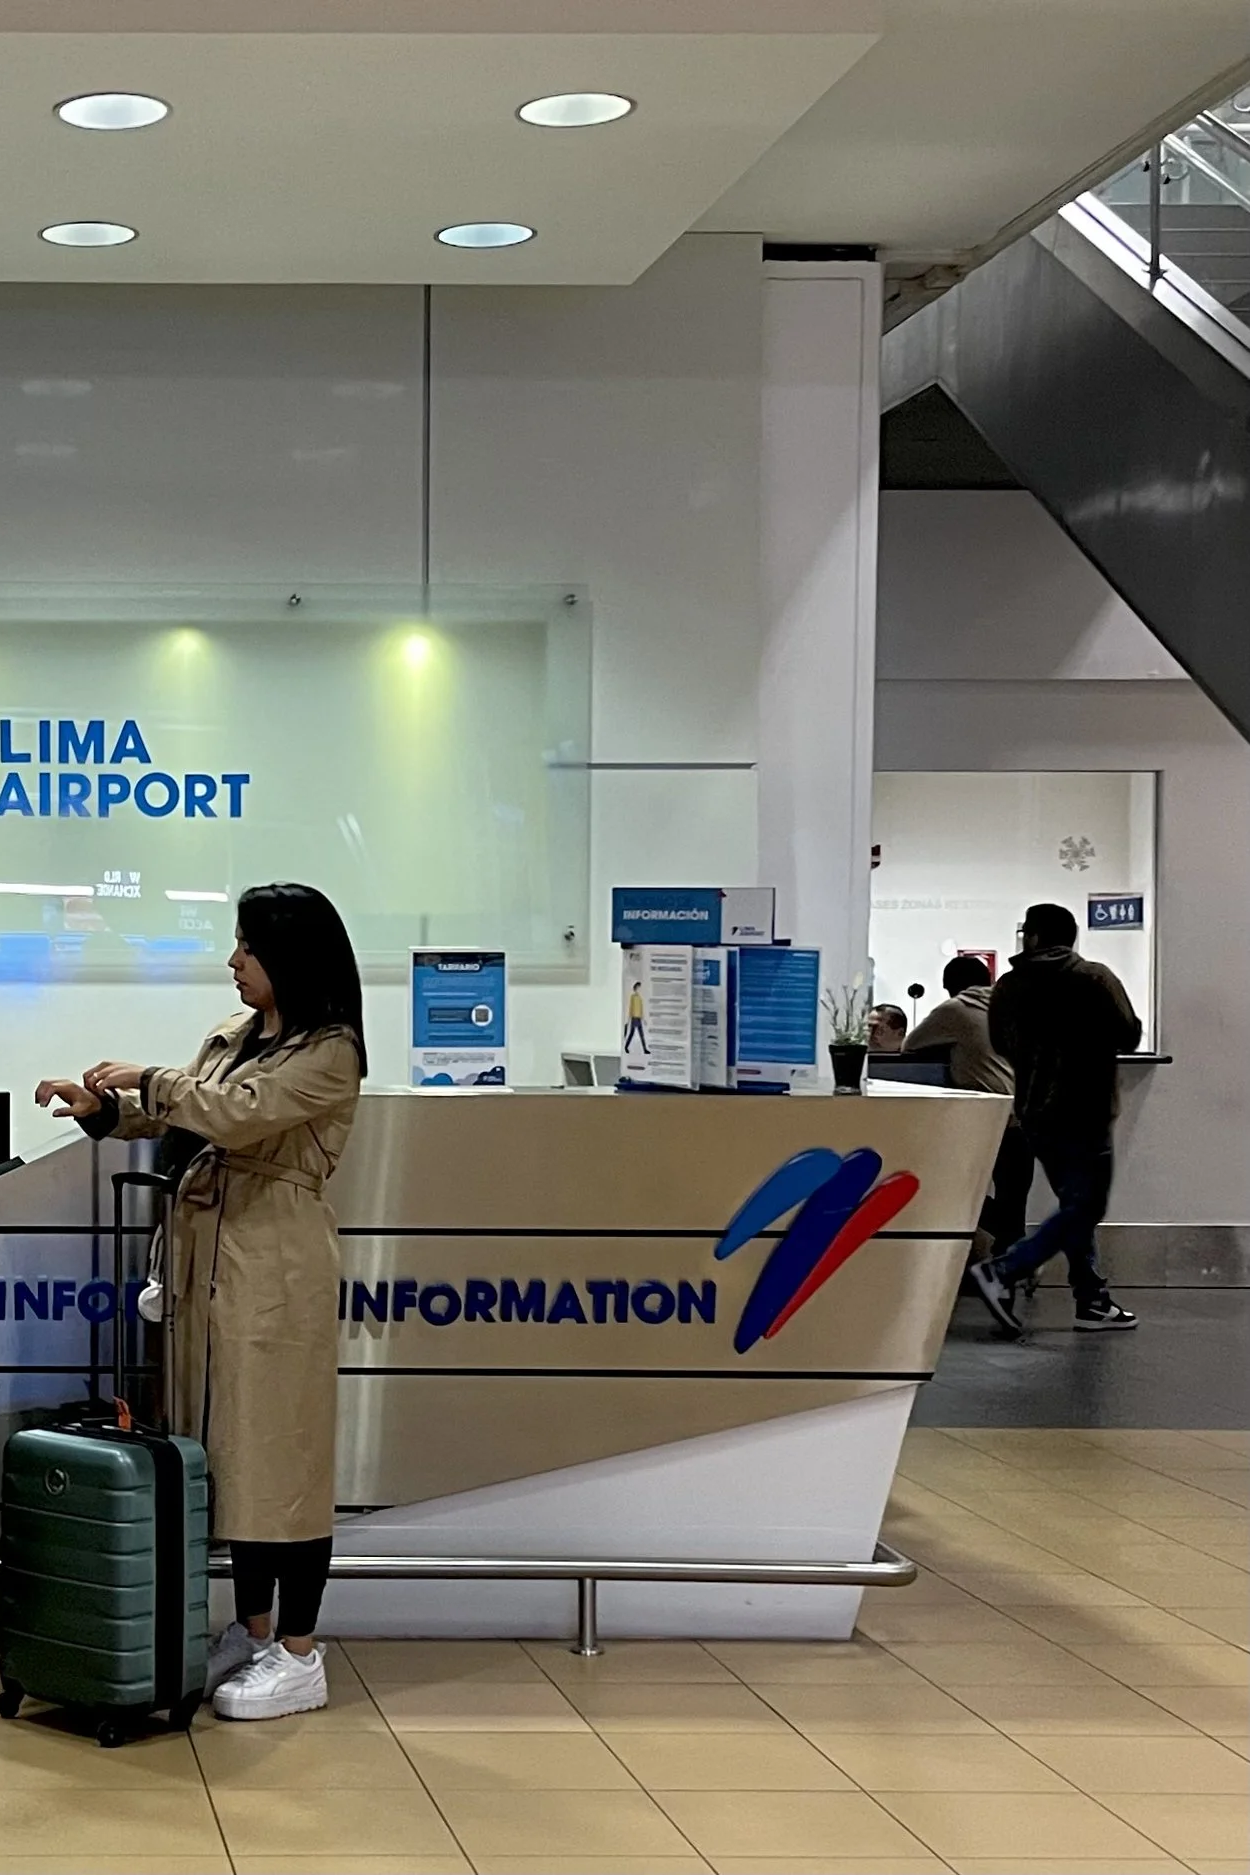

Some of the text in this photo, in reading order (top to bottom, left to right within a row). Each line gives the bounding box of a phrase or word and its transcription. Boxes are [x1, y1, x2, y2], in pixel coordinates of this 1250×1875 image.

[0, 719, 152, 764] LIMA
[622, 908, 709, 921] INFORMACIÓN
[337, 1278, 717, 1326] INFORMATION
